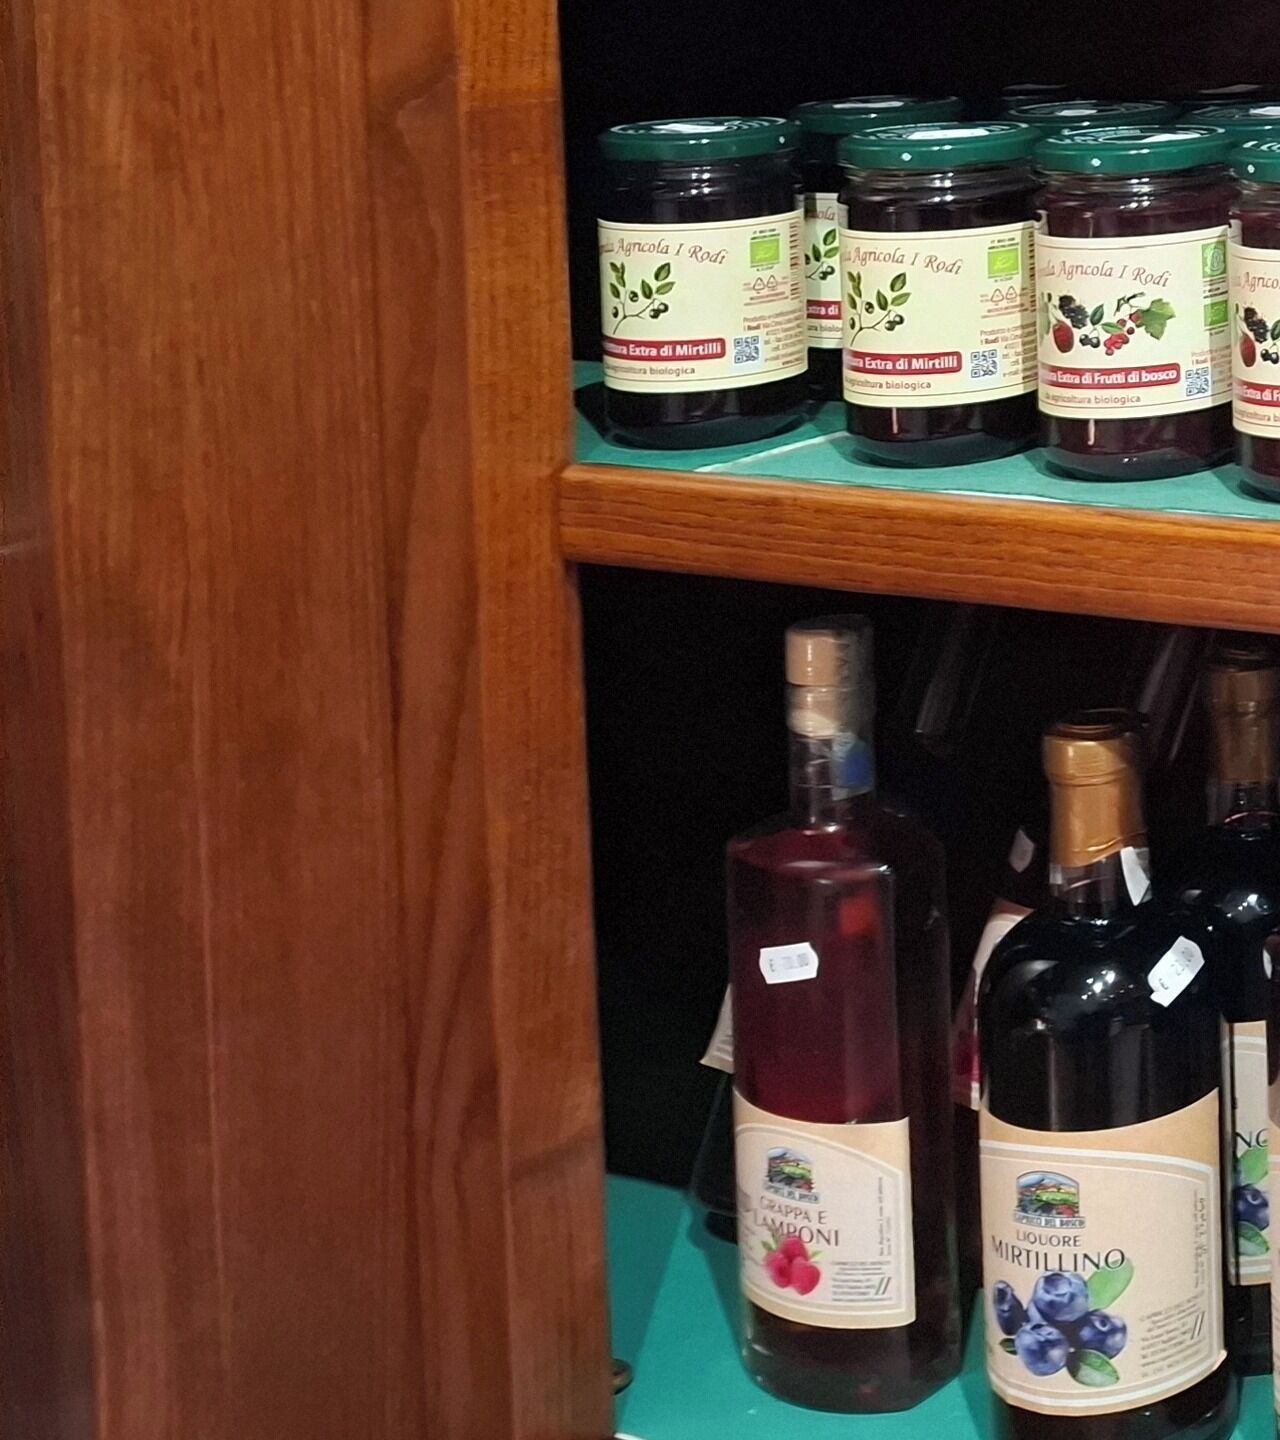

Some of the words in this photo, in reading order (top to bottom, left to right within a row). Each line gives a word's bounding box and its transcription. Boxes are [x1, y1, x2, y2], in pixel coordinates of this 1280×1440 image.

[615, 238, 670, 258] Agricola
[687, 245, 728, 265] Rodi
[853, 247, 906, 266] Agricola
[923, 255, 963, 275] Rodi
[1055, 260, 1113, 281] Agricola
[1132, 267, 1172, 287] Rodi
[629, 344, 658, 358] Extra
[660, 345, 673, 357] di
[675, 342, 722, 356] Mirtilli
[649, 365, 696, 378] biologica
[864, 358, 894, 370] Extra
[895, 359, 909, 371] di
[911, 356, 958, 370] Mirtilli
[885, 379, 932, 391] biologica
[1081, 372, 1093, 384] di
[1094, 372, 1126, 384] Frutti
[1127, 371, 1140, 383] di
[1141, 369, 1177, 382] bosco
[1094, 394, 1141, 405] biologica
[760, 1195, 812, 1223] GRAPPA
[817, 1210, 828, 1225] E
[755, 1211, 840, 1247] LAMPONI
[1016, 1229, 1082, 1248] LIQUORE
[991, 1235, 1126, 1274] MIRTILLINO
